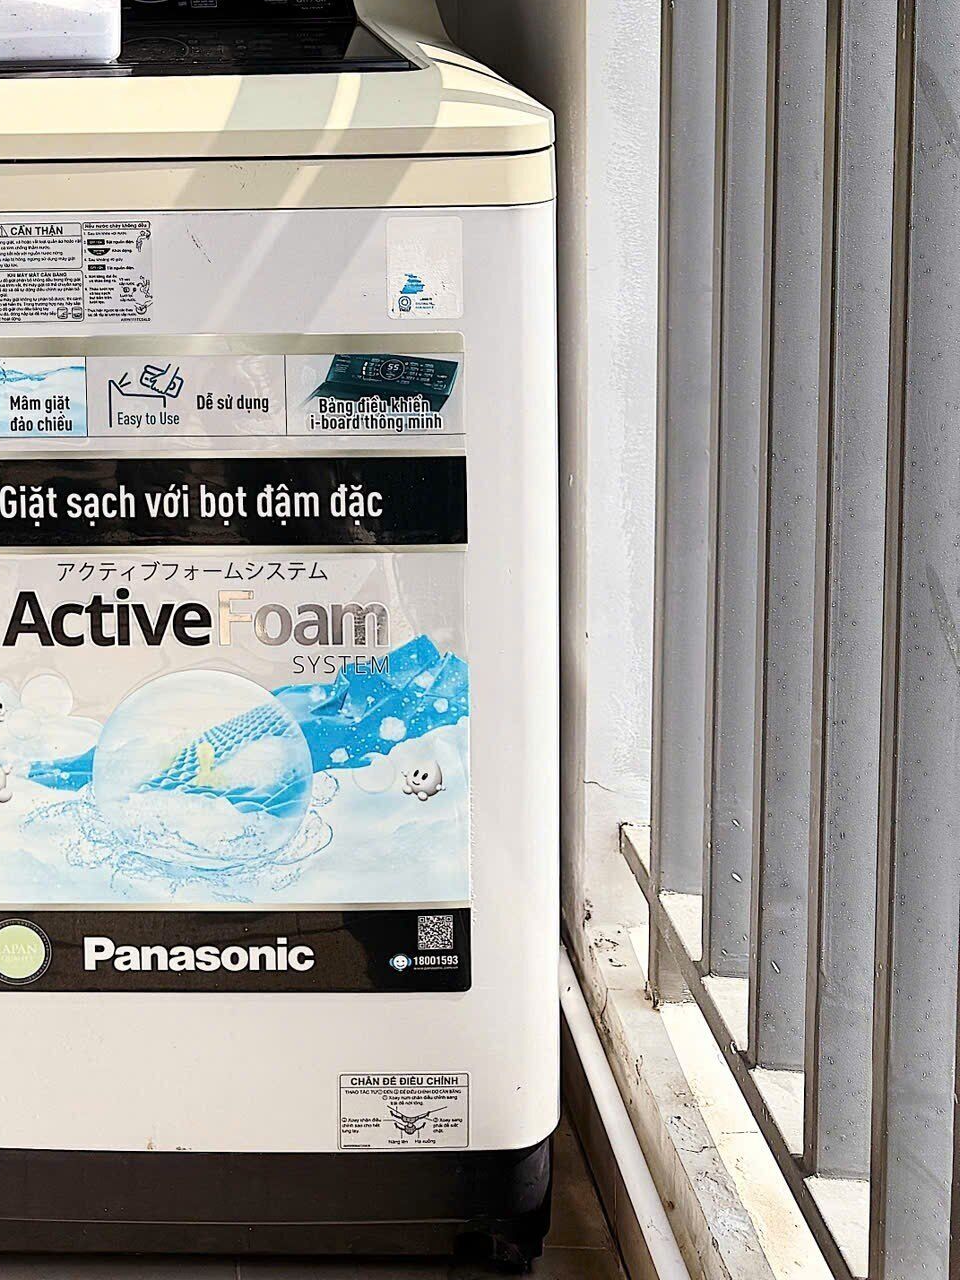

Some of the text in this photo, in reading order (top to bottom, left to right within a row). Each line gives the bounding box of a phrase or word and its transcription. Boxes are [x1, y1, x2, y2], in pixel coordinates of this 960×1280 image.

[35, 224, 63, 237] THẬN
[10, 395, 71, 414] Mâm giặt
[196, 393, 269, 414] Dễ sử dụng
[319, 394, 430, 417] Bảng điều khiển
[10, 414, 73, 432] đảo chiều
[117, 412, 180, 429] Easy to Use
[310, 413, 442, 433] i-board thông minh
[0, 483, 383, 527] Giặt sạch với bọt đậm đặc
[56, 561, 328, 582] アクティブフォームシステム
[292, 655, 390, 674] SYSTEM
[82, 936, 315, 972] Panasonic
[413, 955, 459, 966] 18001593
[350, 1075, 380, 1086] CHÂN
